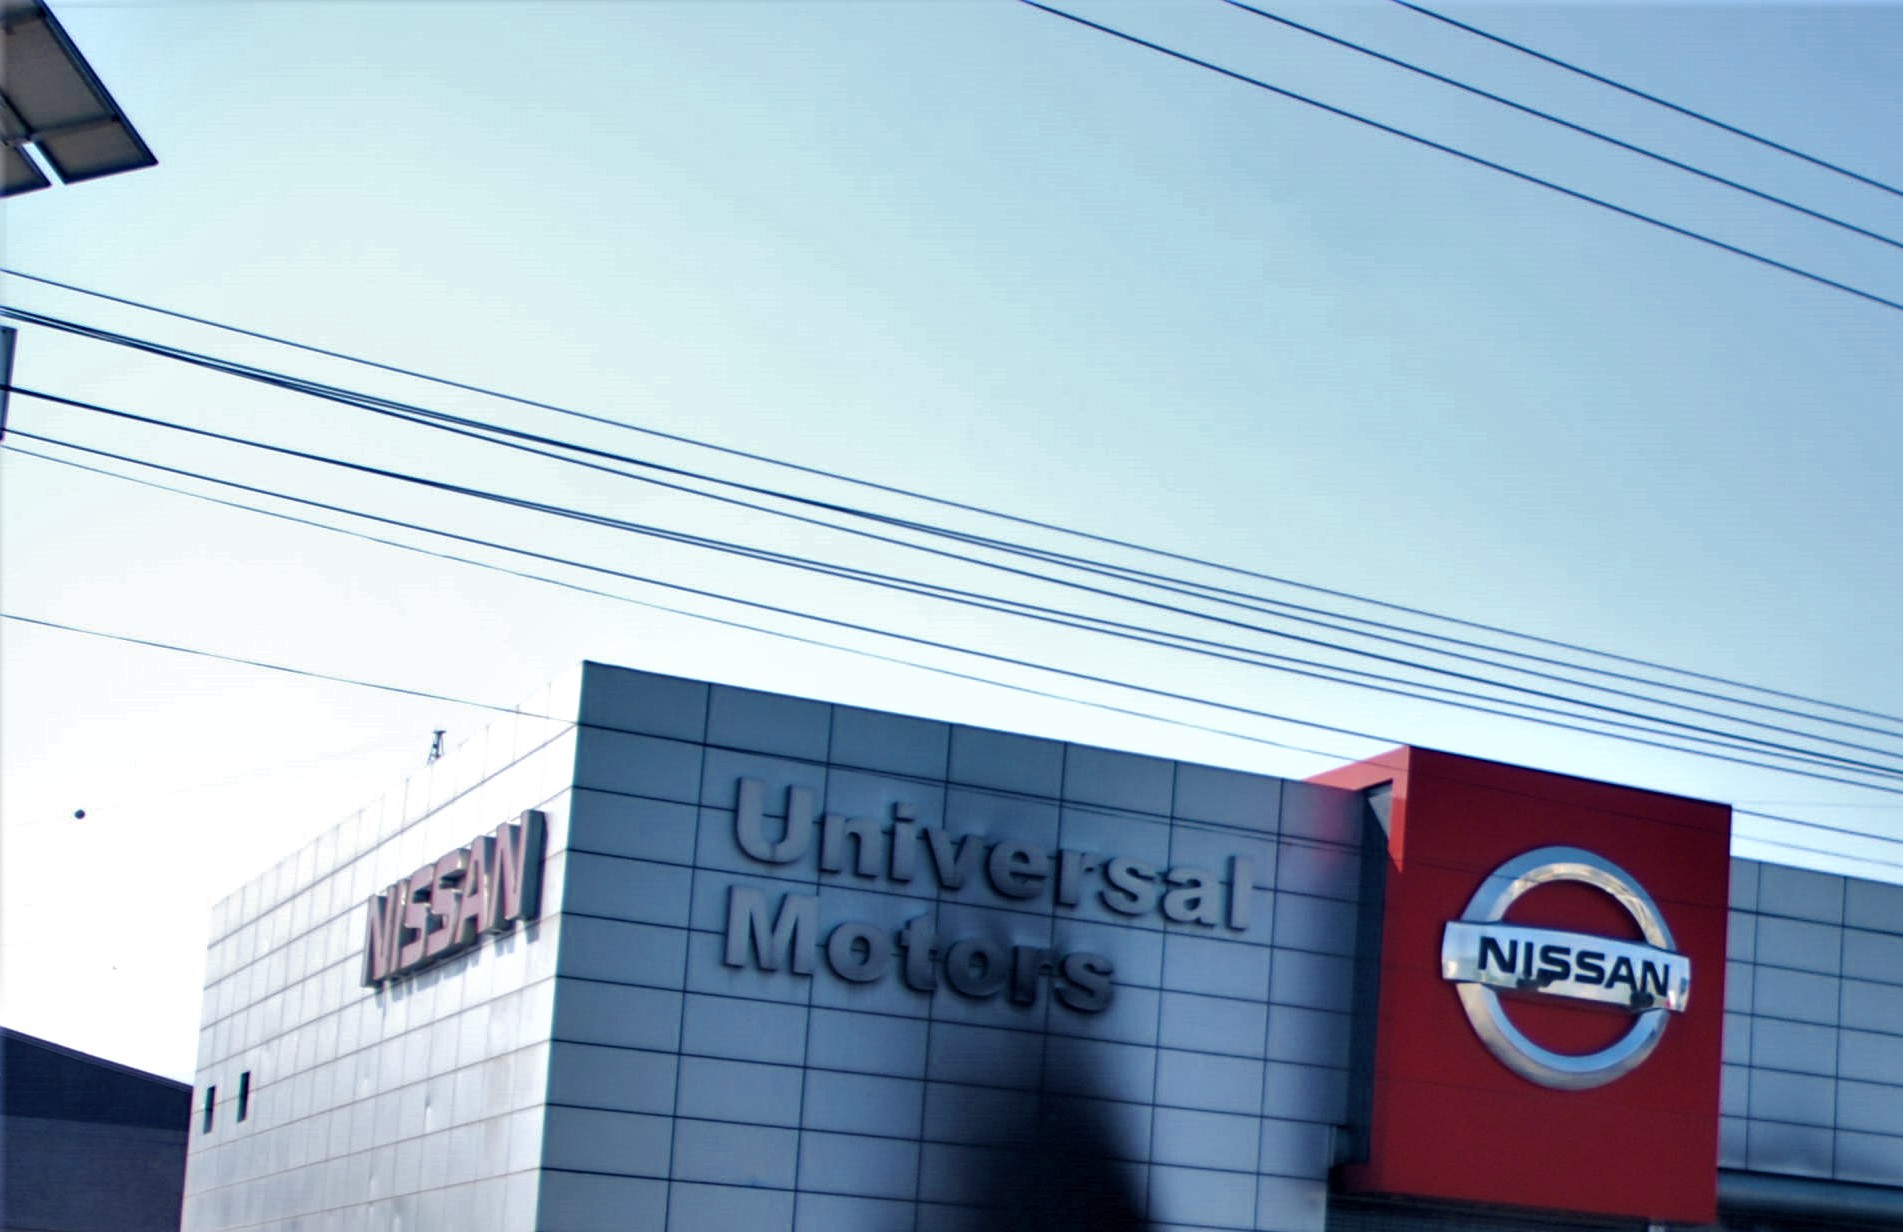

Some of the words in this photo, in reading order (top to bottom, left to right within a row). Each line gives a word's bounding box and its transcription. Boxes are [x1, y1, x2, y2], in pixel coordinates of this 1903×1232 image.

[360, 809, 548, 988] NISSAN
[733, 775, 1255, 932] Universal
[722, 884, 1116, 1014] Motors
[1477, 935, 1670, 997] NISSAN
